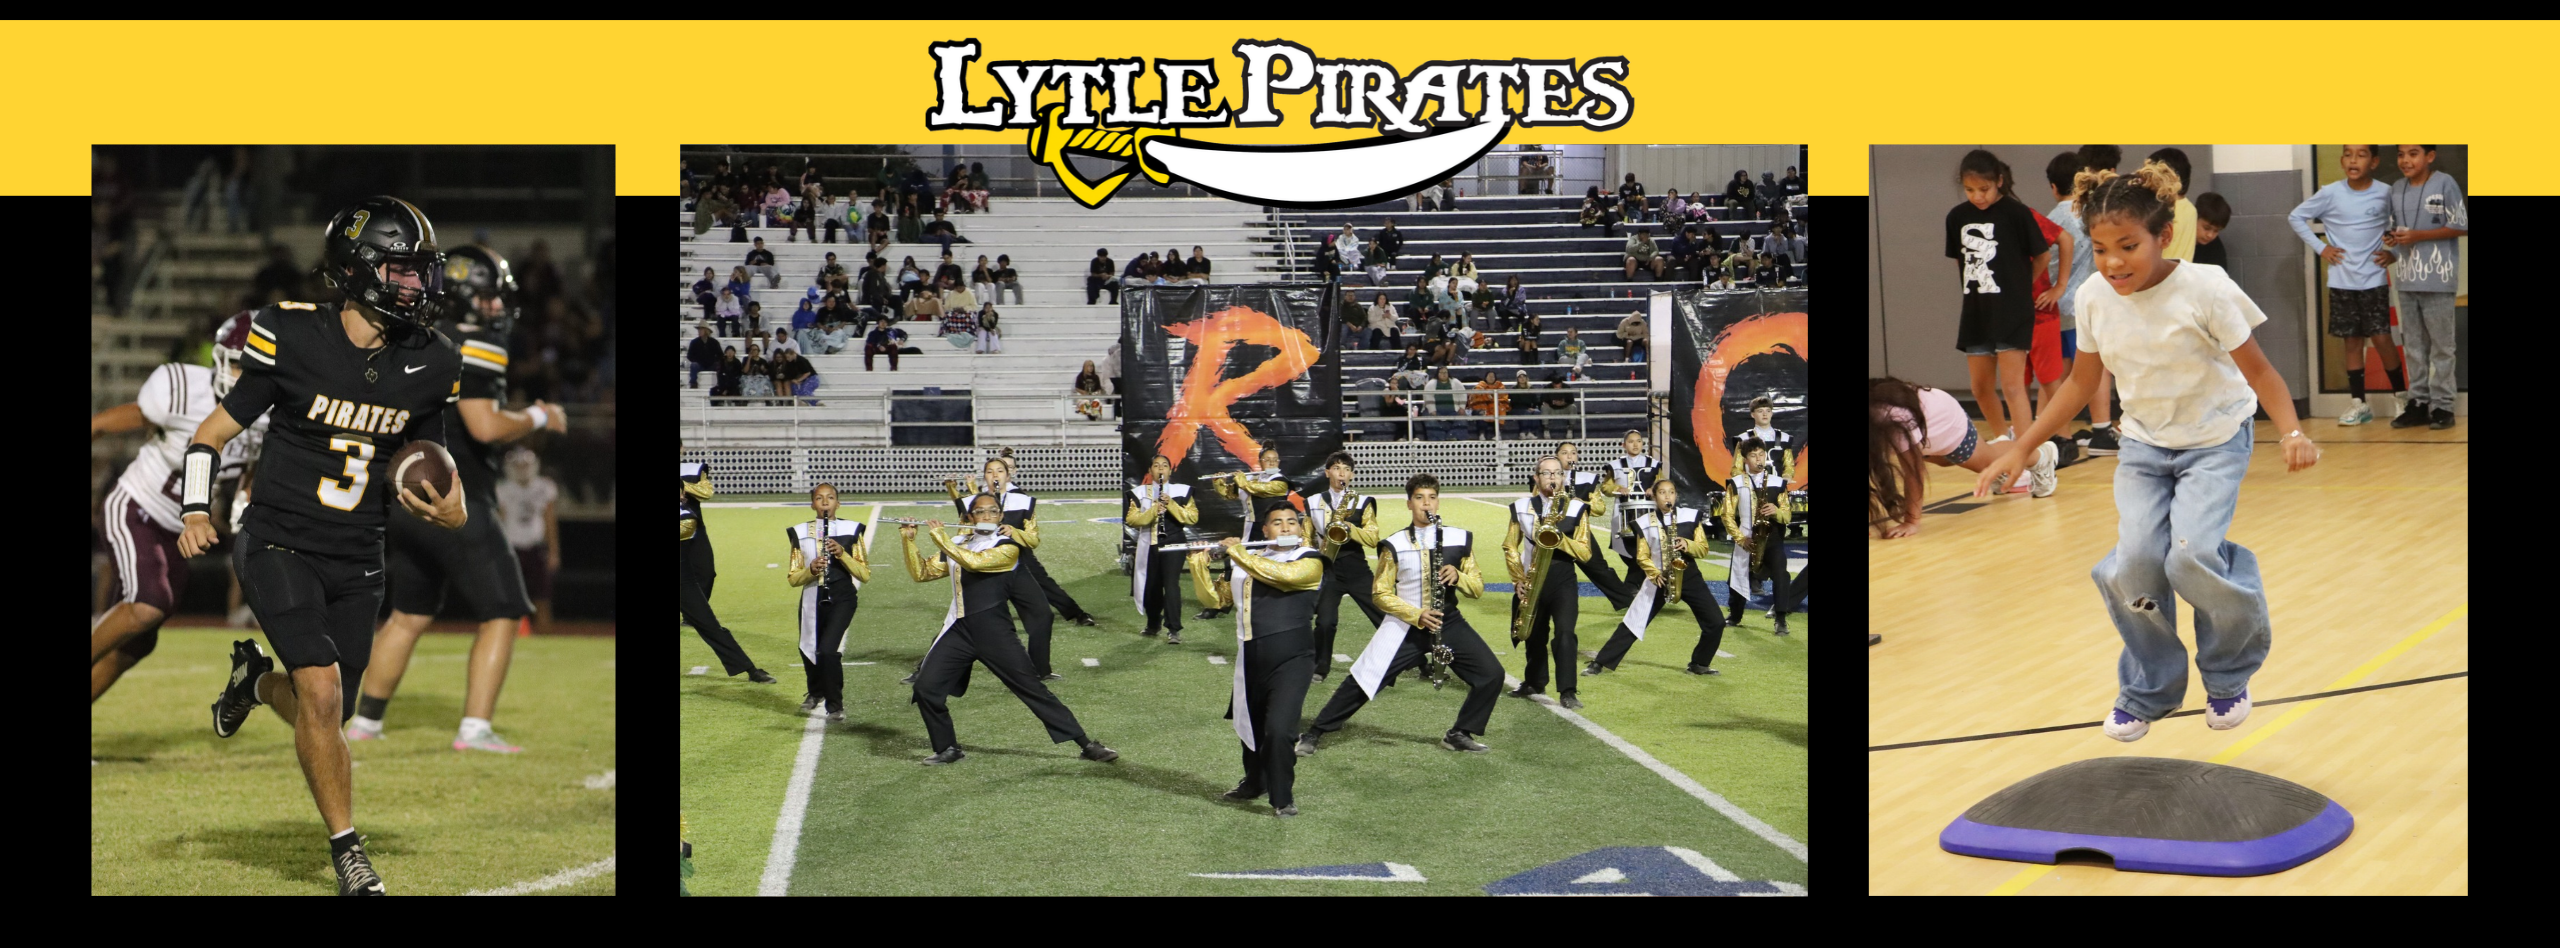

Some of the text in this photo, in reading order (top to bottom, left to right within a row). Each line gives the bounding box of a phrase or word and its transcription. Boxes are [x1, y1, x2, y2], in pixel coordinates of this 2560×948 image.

[345, 210, 371, 240] 3
[306, 393, 411, 435] PIRATES
[1142, 305, 1321, 508] R
[316, 432, 376, 512] 3
[231, 660, 249, 688] NIKE
